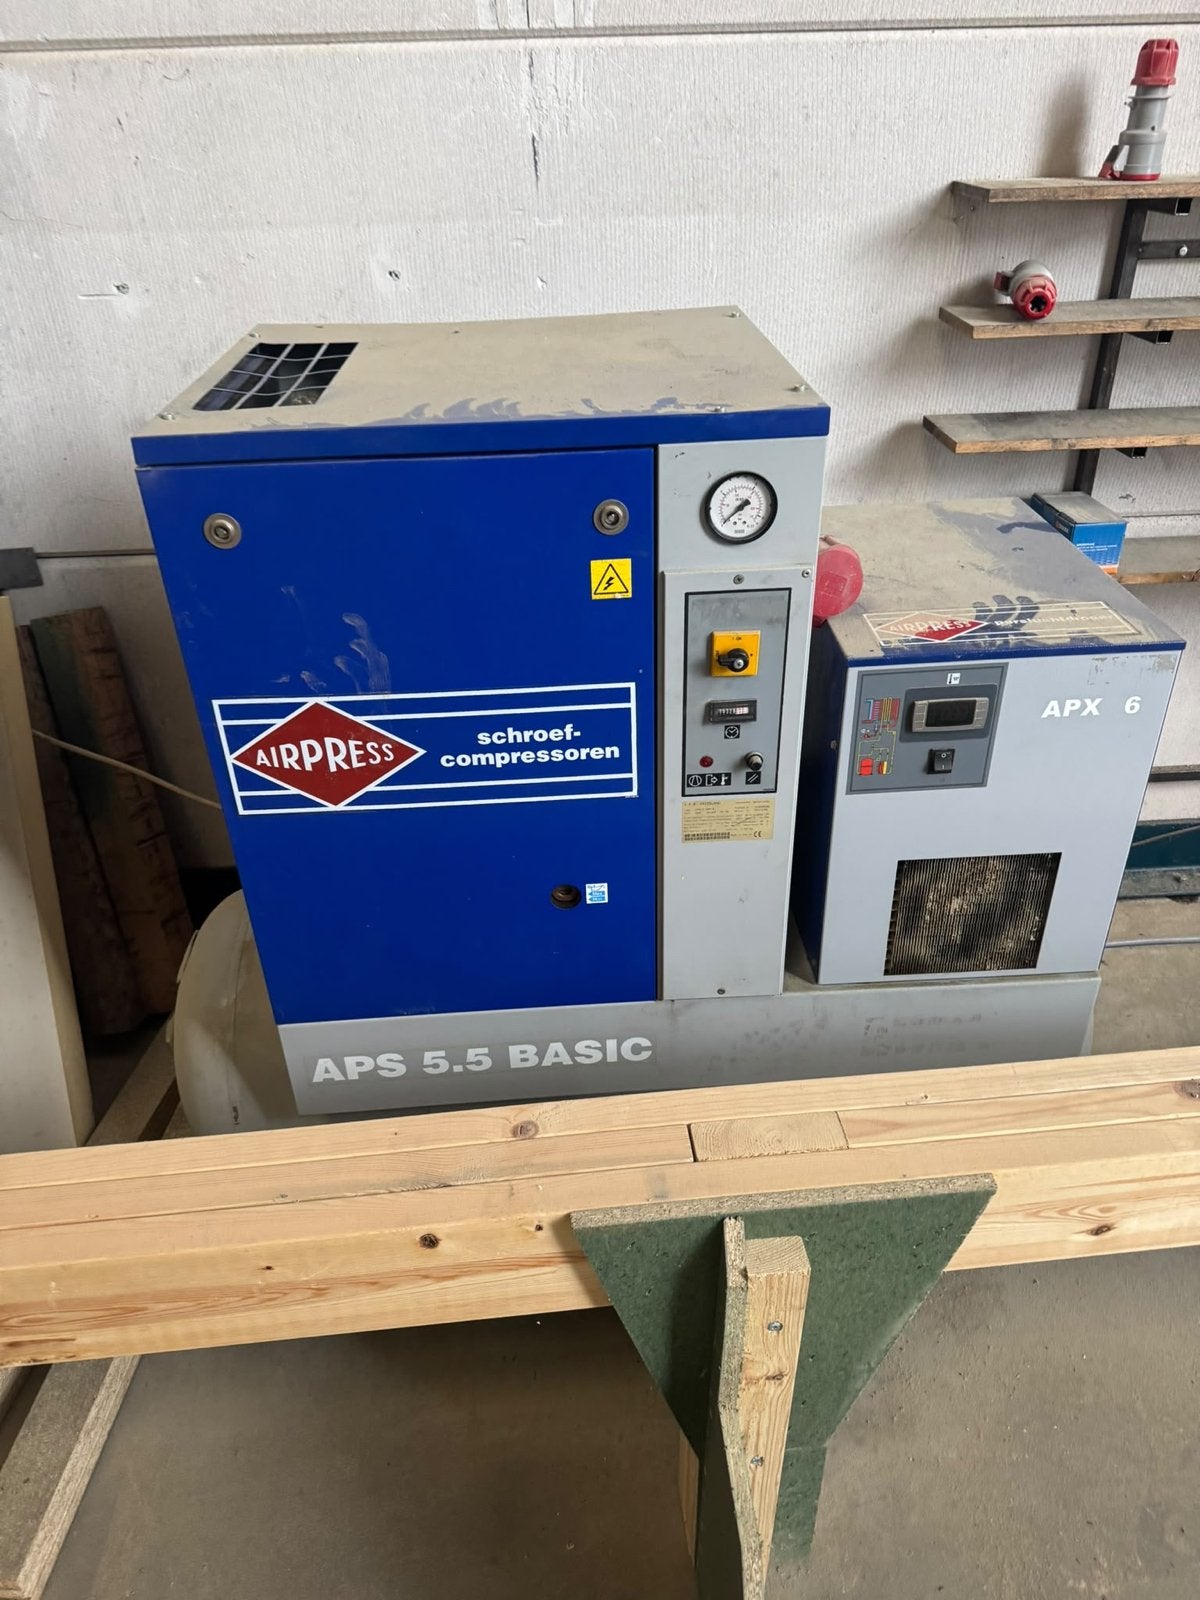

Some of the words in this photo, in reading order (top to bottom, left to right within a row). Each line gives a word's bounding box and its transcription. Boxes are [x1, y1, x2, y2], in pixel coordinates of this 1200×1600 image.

[1041, 698, 1103, 718] APX
[1124, 696, 1141, 714] 6
[477, 724, 581, 745] schroef-
[256, 737, 395, 773] AIRPRESS
[440, 744, 620, 768] compressoren
[312, 1053, 407, 1082] APS
[422, 1047, 493, 1075] 5.5
[508, 1037, 652, 1068] BASIC
